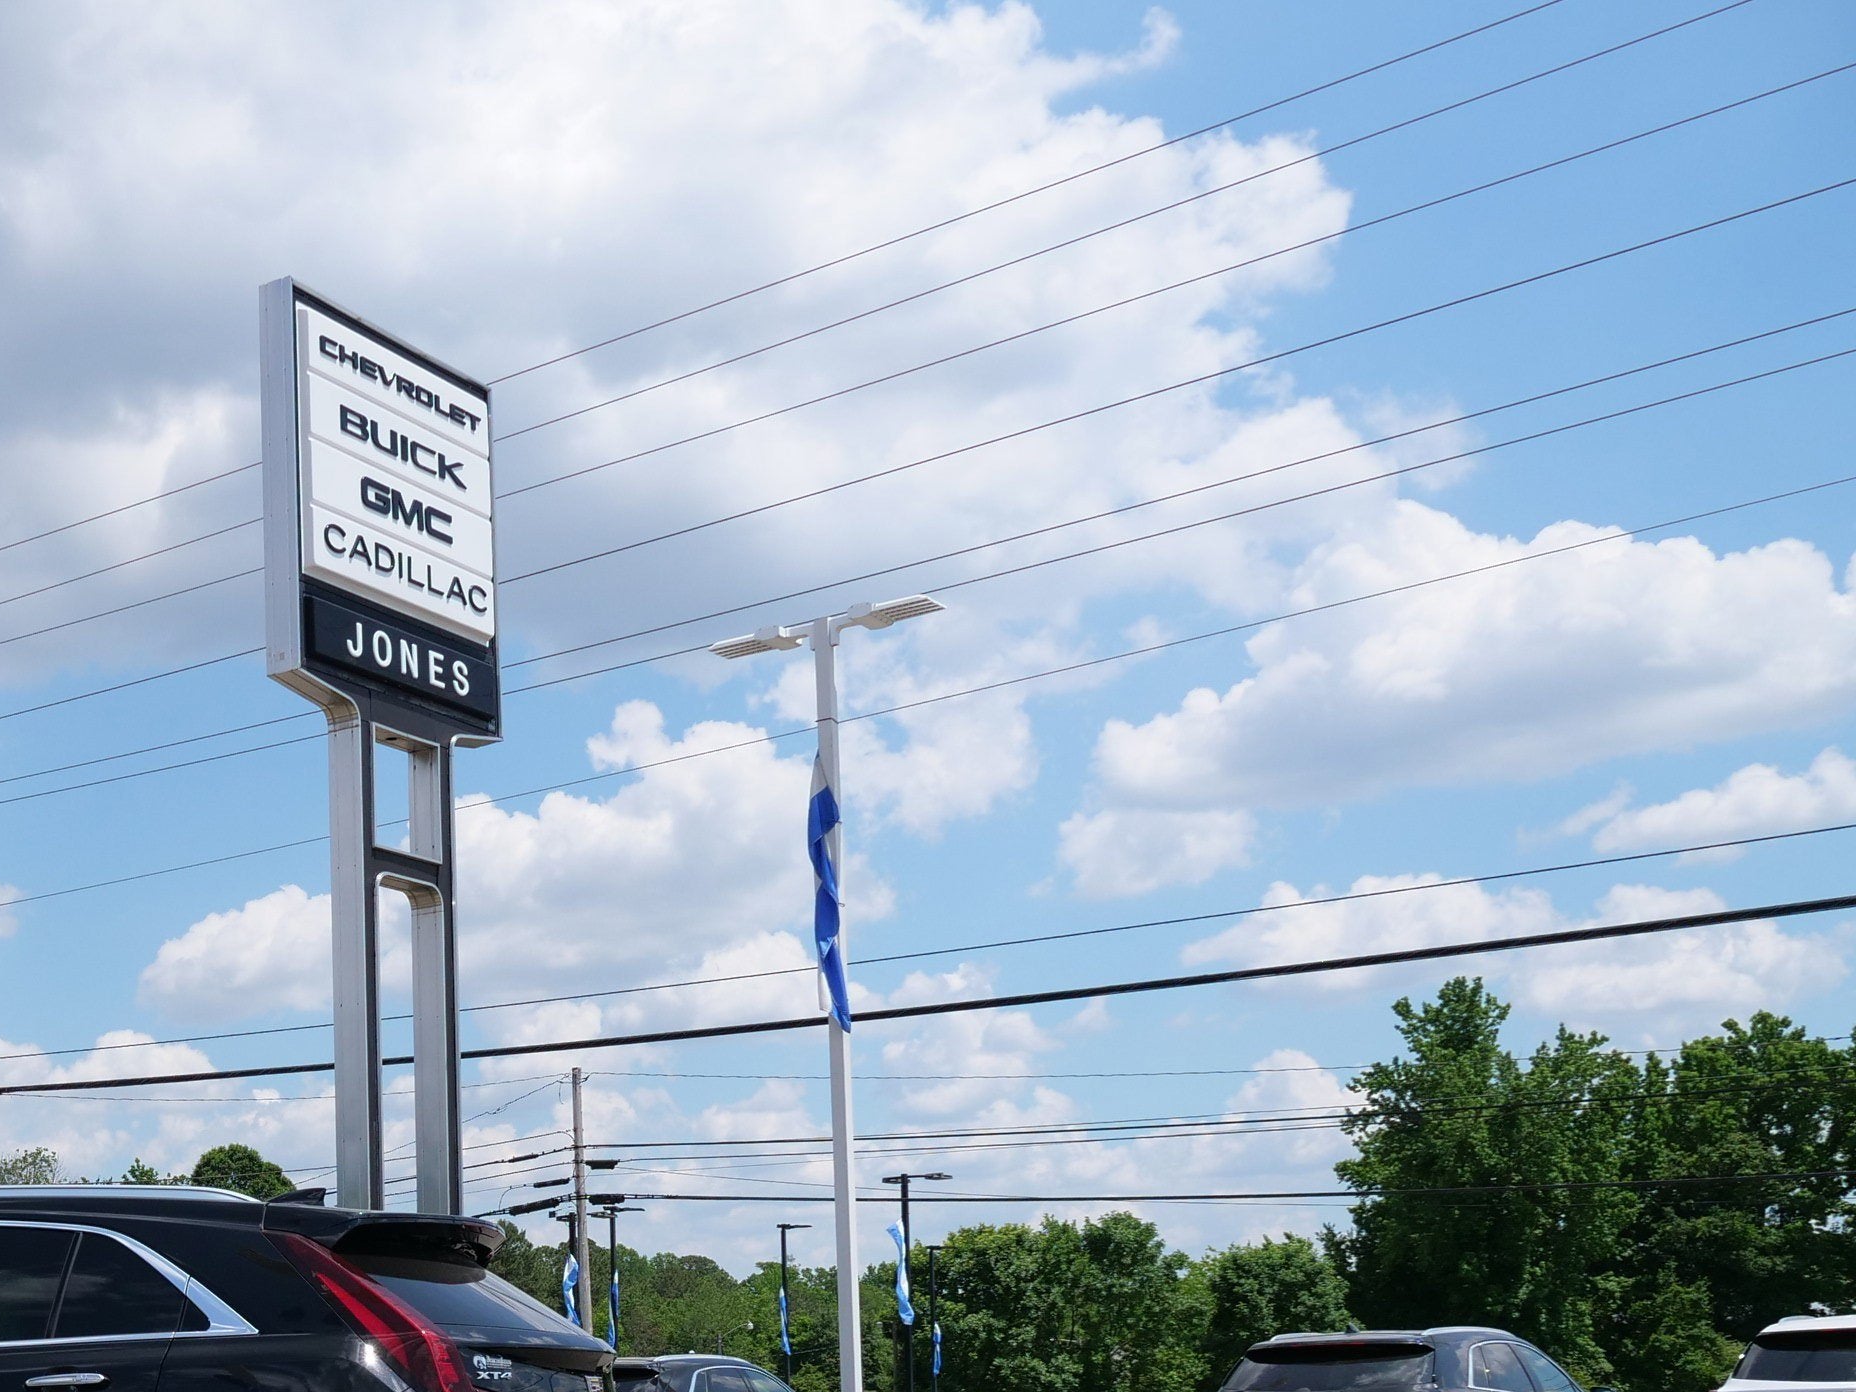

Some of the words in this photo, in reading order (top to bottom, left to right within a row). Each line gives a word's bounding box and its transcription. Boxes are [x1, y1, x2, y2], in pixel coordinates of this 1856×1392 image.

[319, 334, 481, 433] CHEVROLET
[340, 404, 467, 490] BUICK
[361, 476, 454, 544] GMC
[324, 524, 488, 613] CADILLAC
[347, 622, 470, 696] JONES
[477, 1371, 512, 1379] XT4
